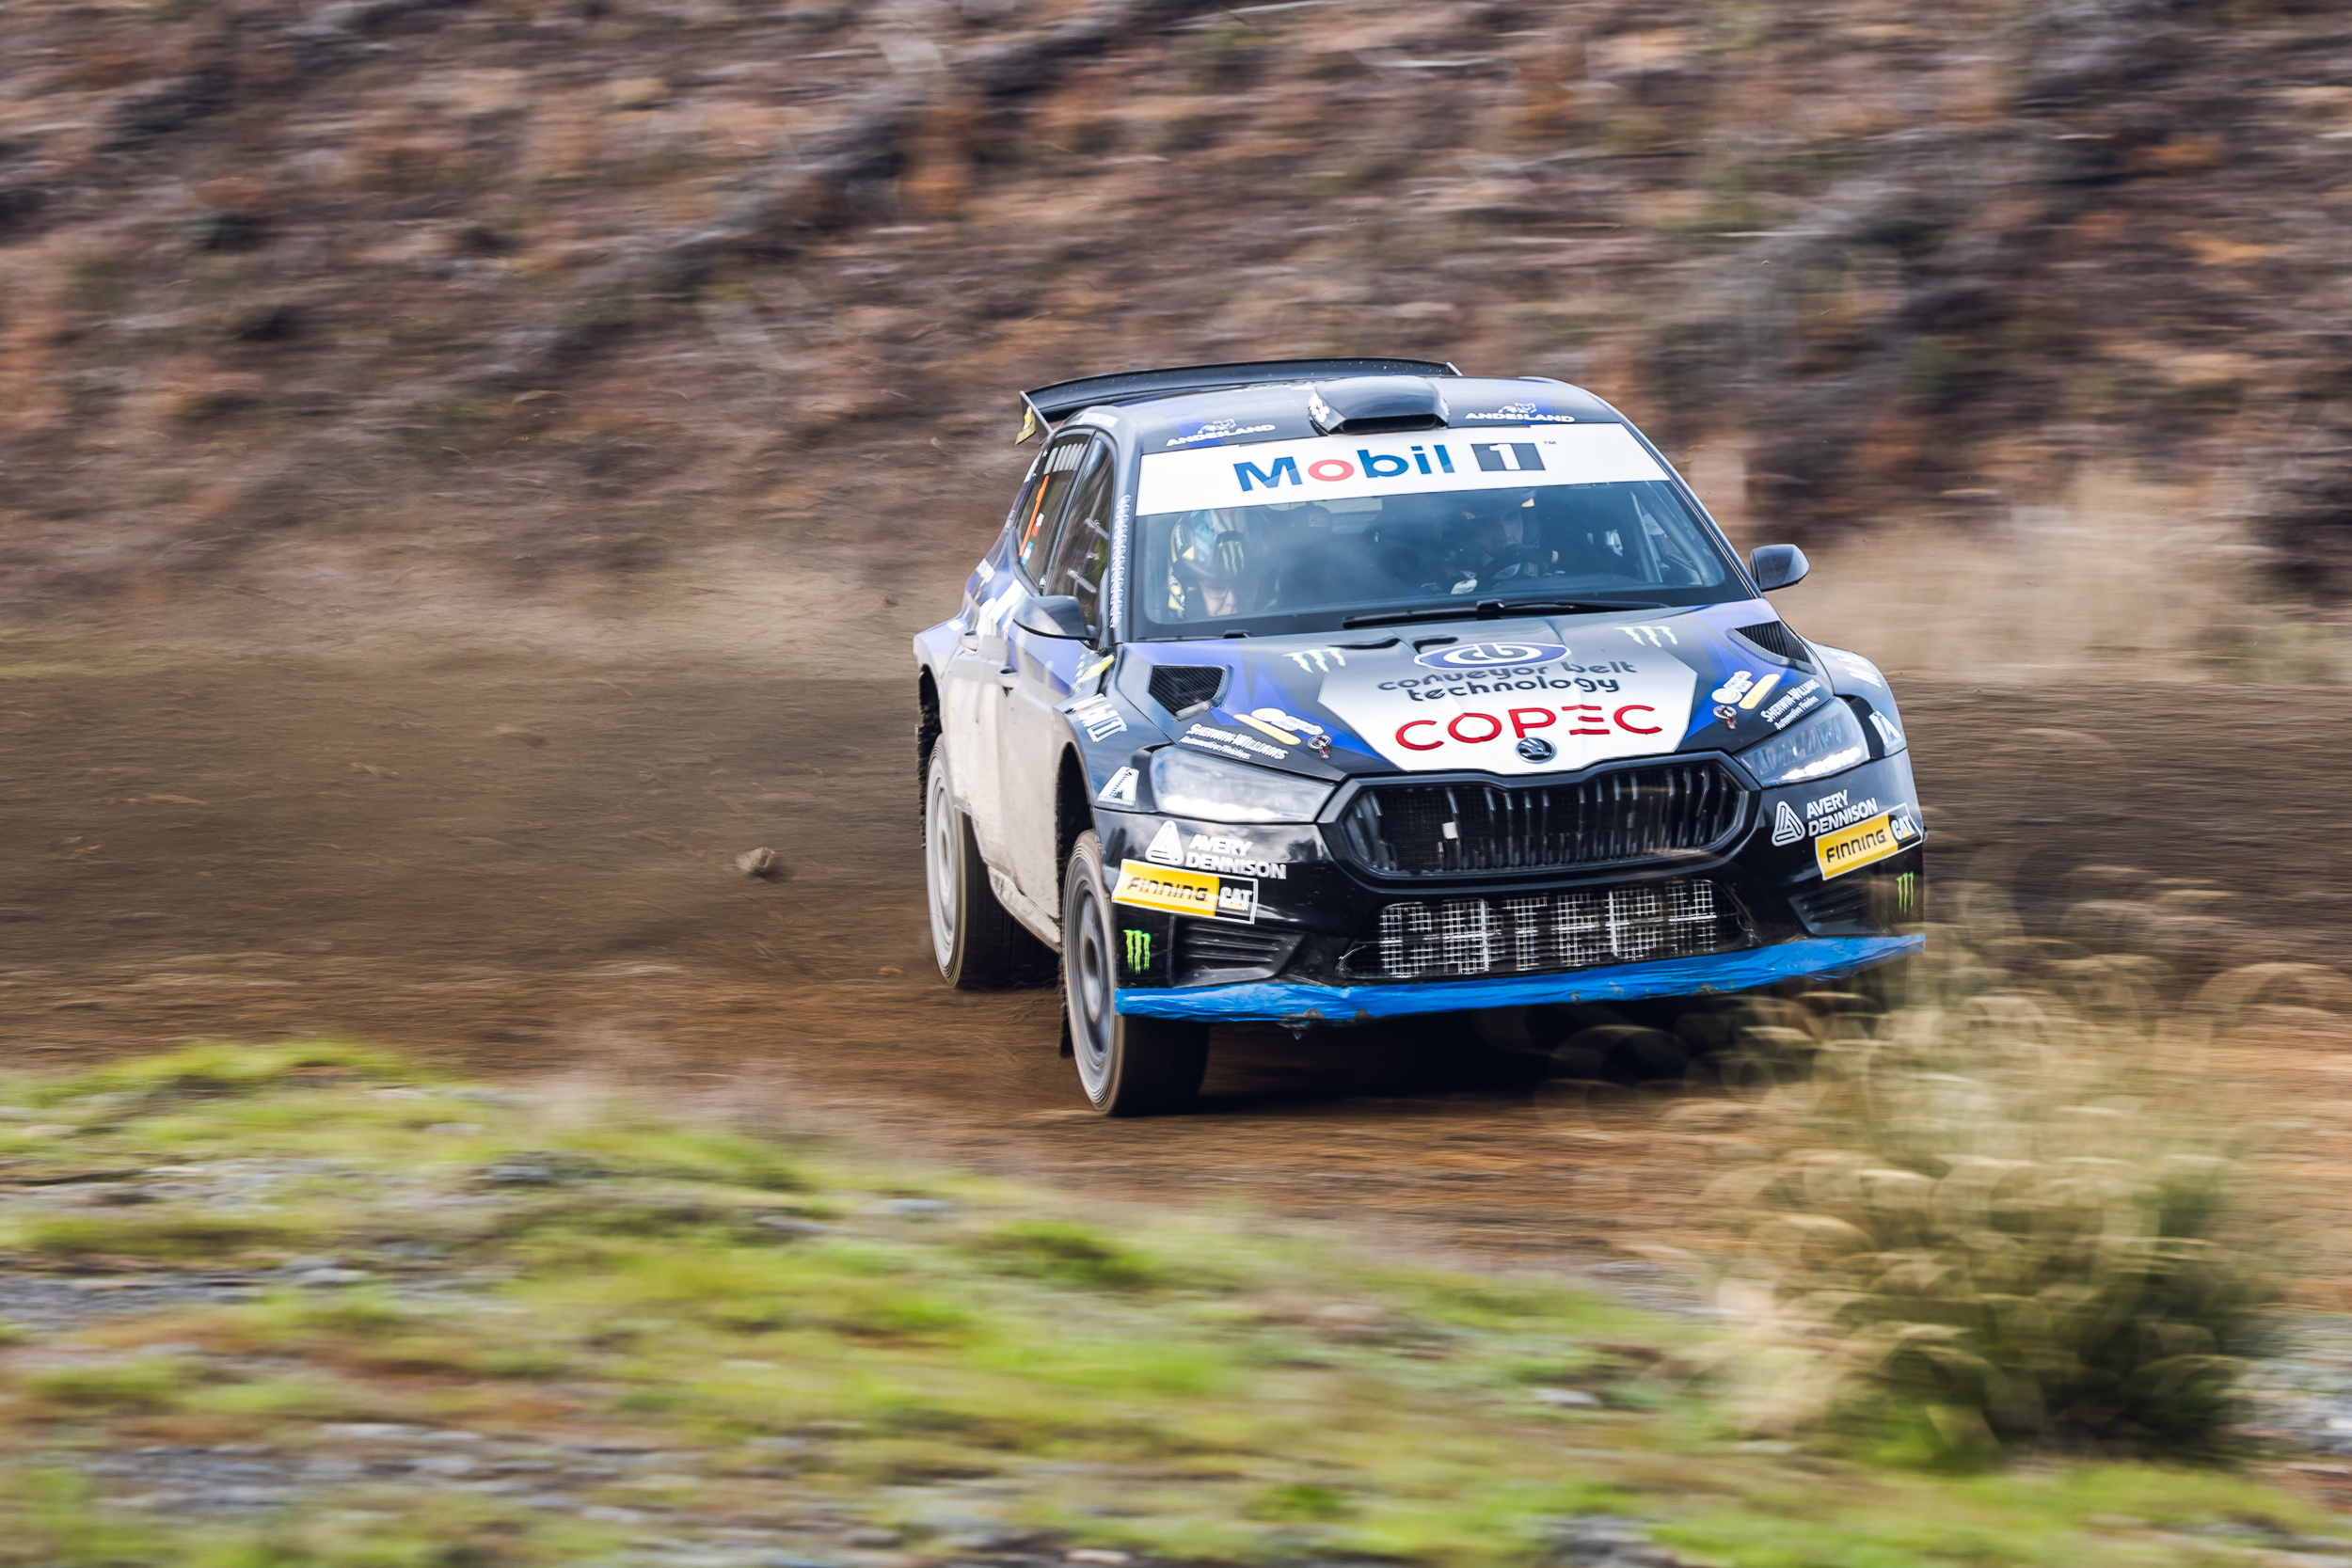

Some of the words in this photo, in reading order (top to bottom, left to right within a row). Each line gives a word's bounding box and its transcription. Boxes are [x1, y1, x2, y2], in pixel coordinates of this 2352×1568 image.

[1465, 413, 1575, 422] ANDESLAND
[1233, 444, 1455, 492] Mobil
[1377, 665, 1549, 691] conveyor
[1561, 660, 1637, 674] belt
[1406, 675, 1621, 702] technology
[1395, 704, 1663, 751] COPEC
[1806, 789, 1849, 819] AVERY
[1807, 798, 1879, 837] DENNISON
[1188, 834, 1253, 857] AVERY
[1826, 829, 1887, 863] FINNING
[1891, 815, 1915, 841] CAT
[1184, 851, 1287, 879] DENNISON
[1127, 877, 1209, 903] FINNING
[1218, 886, 1254, 911] CAT
